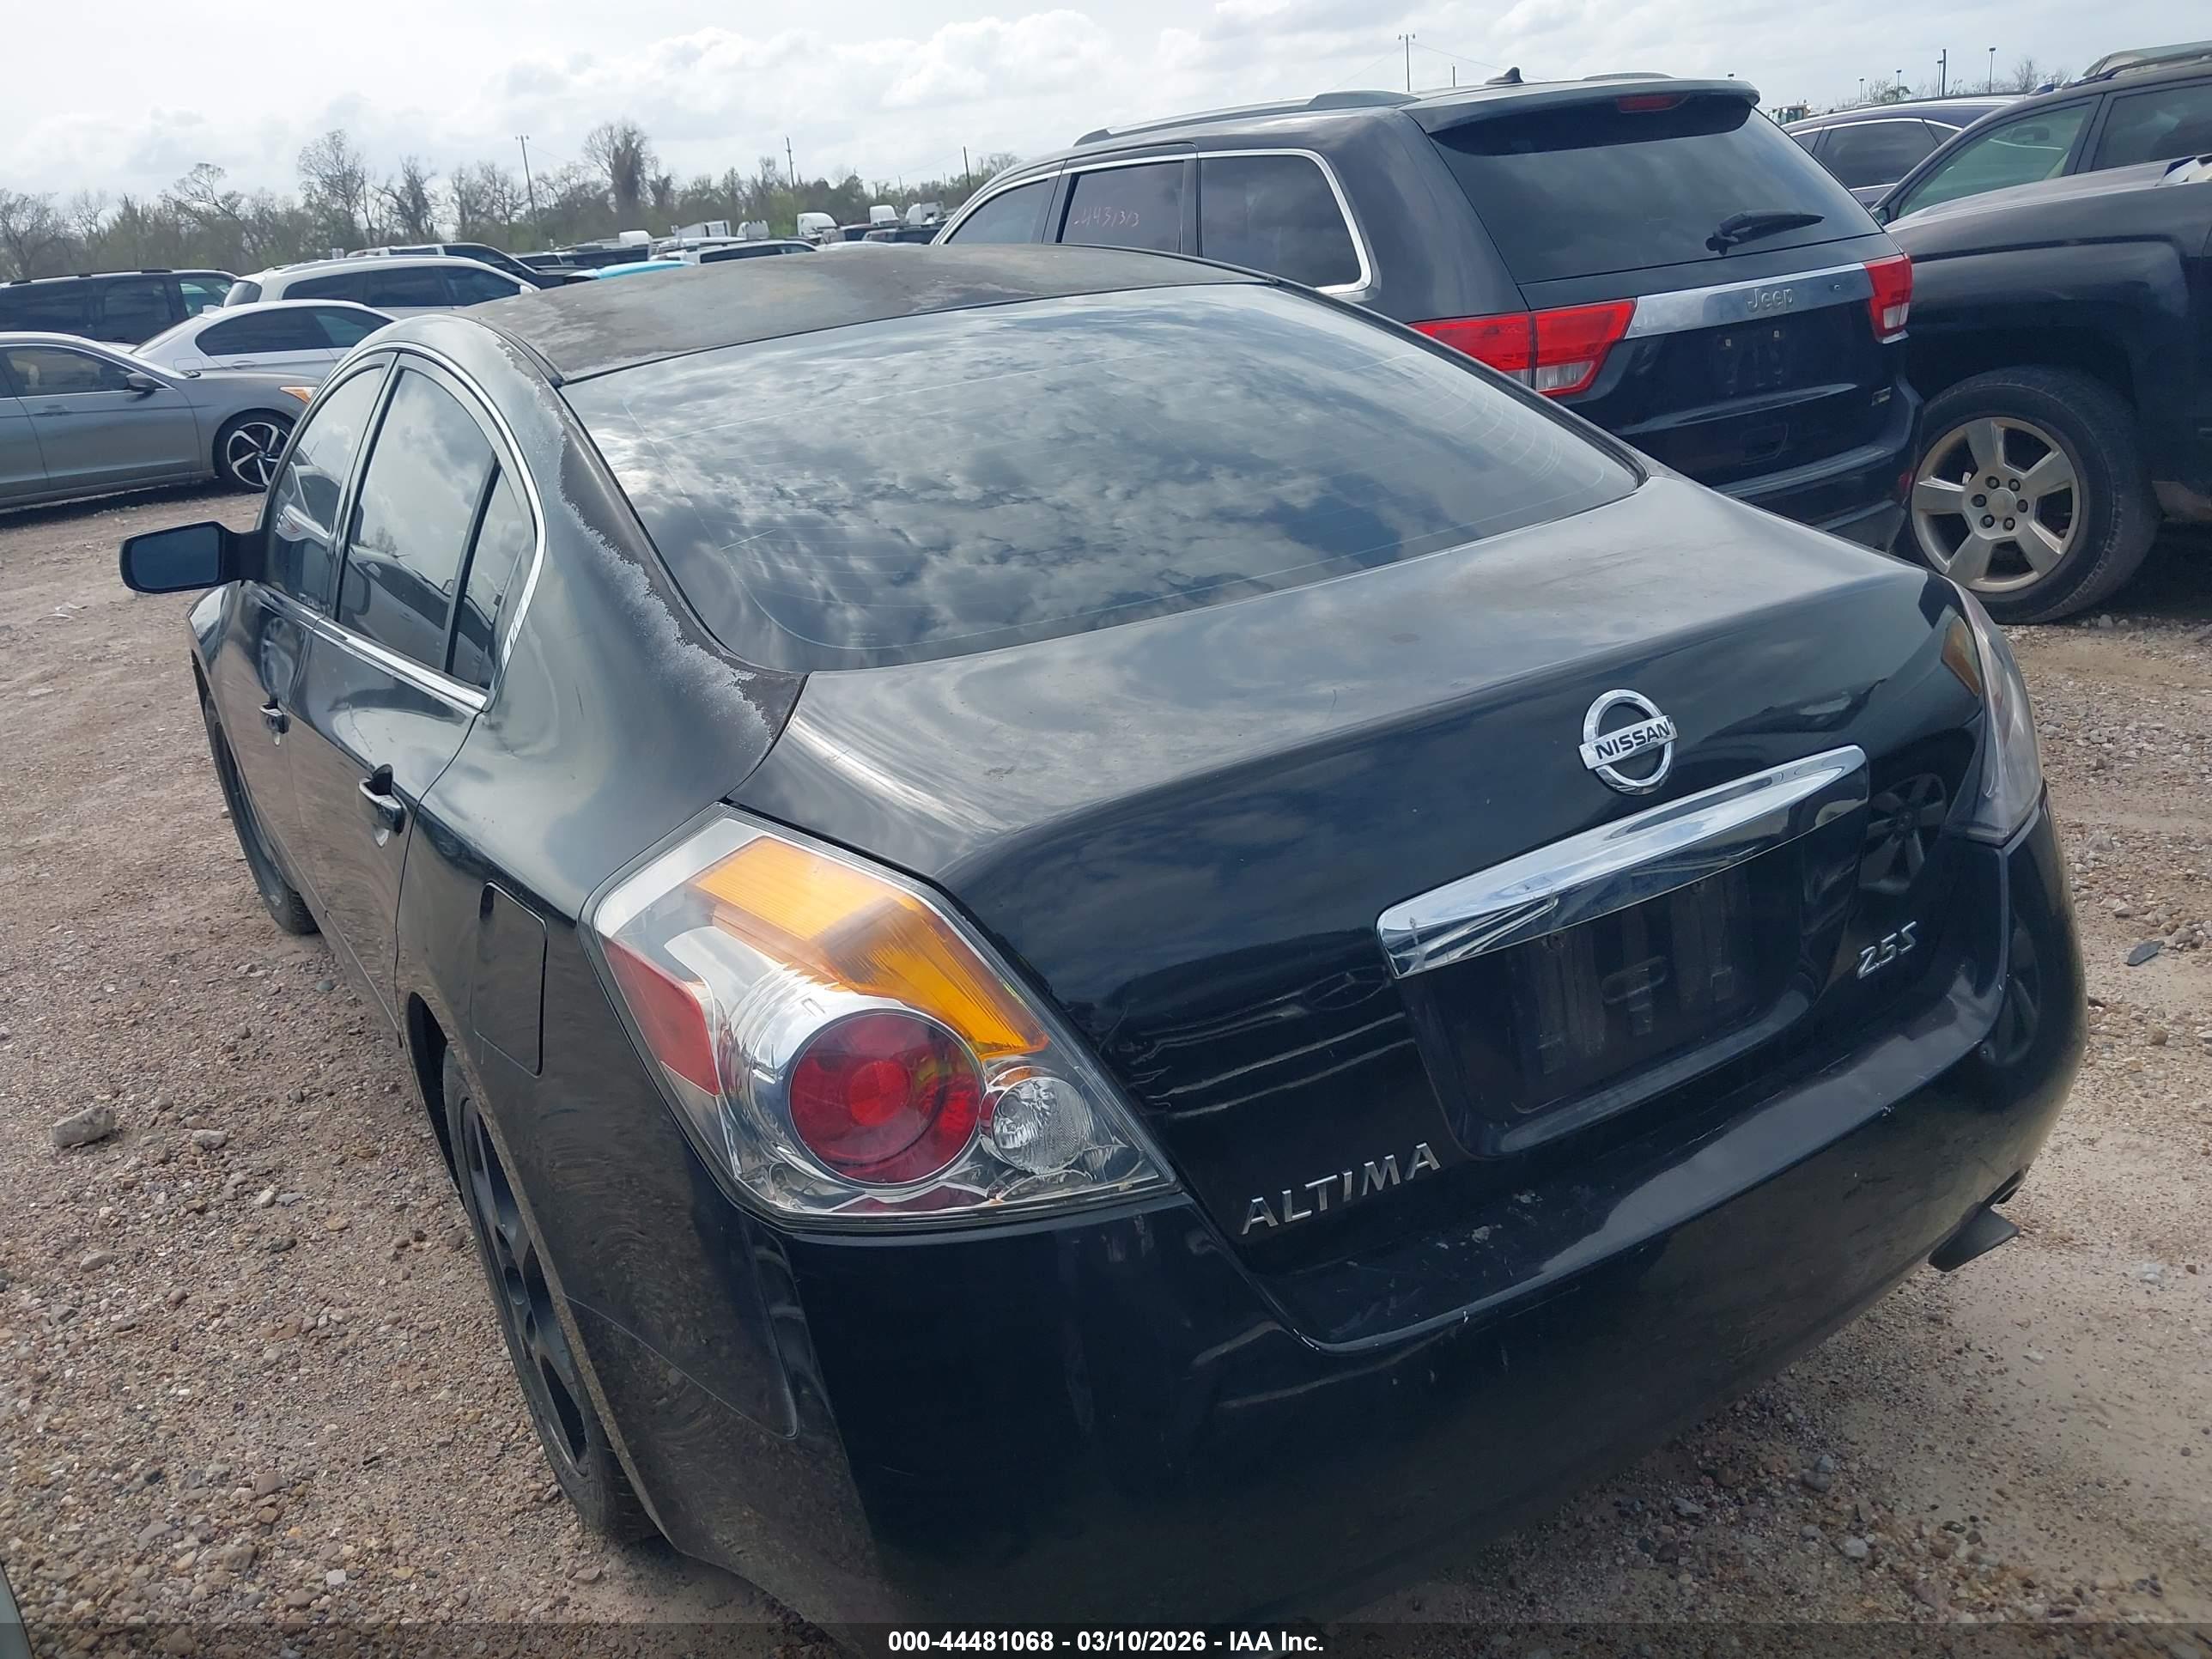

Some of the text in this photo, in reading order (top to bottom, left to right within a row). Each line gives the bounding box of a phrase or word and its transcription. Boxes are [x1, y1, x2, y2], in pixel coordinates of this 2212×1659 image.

[1746, 287, 1794, 313] Jeep
[1595, 720, 1671, 760] NISSAN
[1241, 1141, 1442, 1236] ALTIMA
